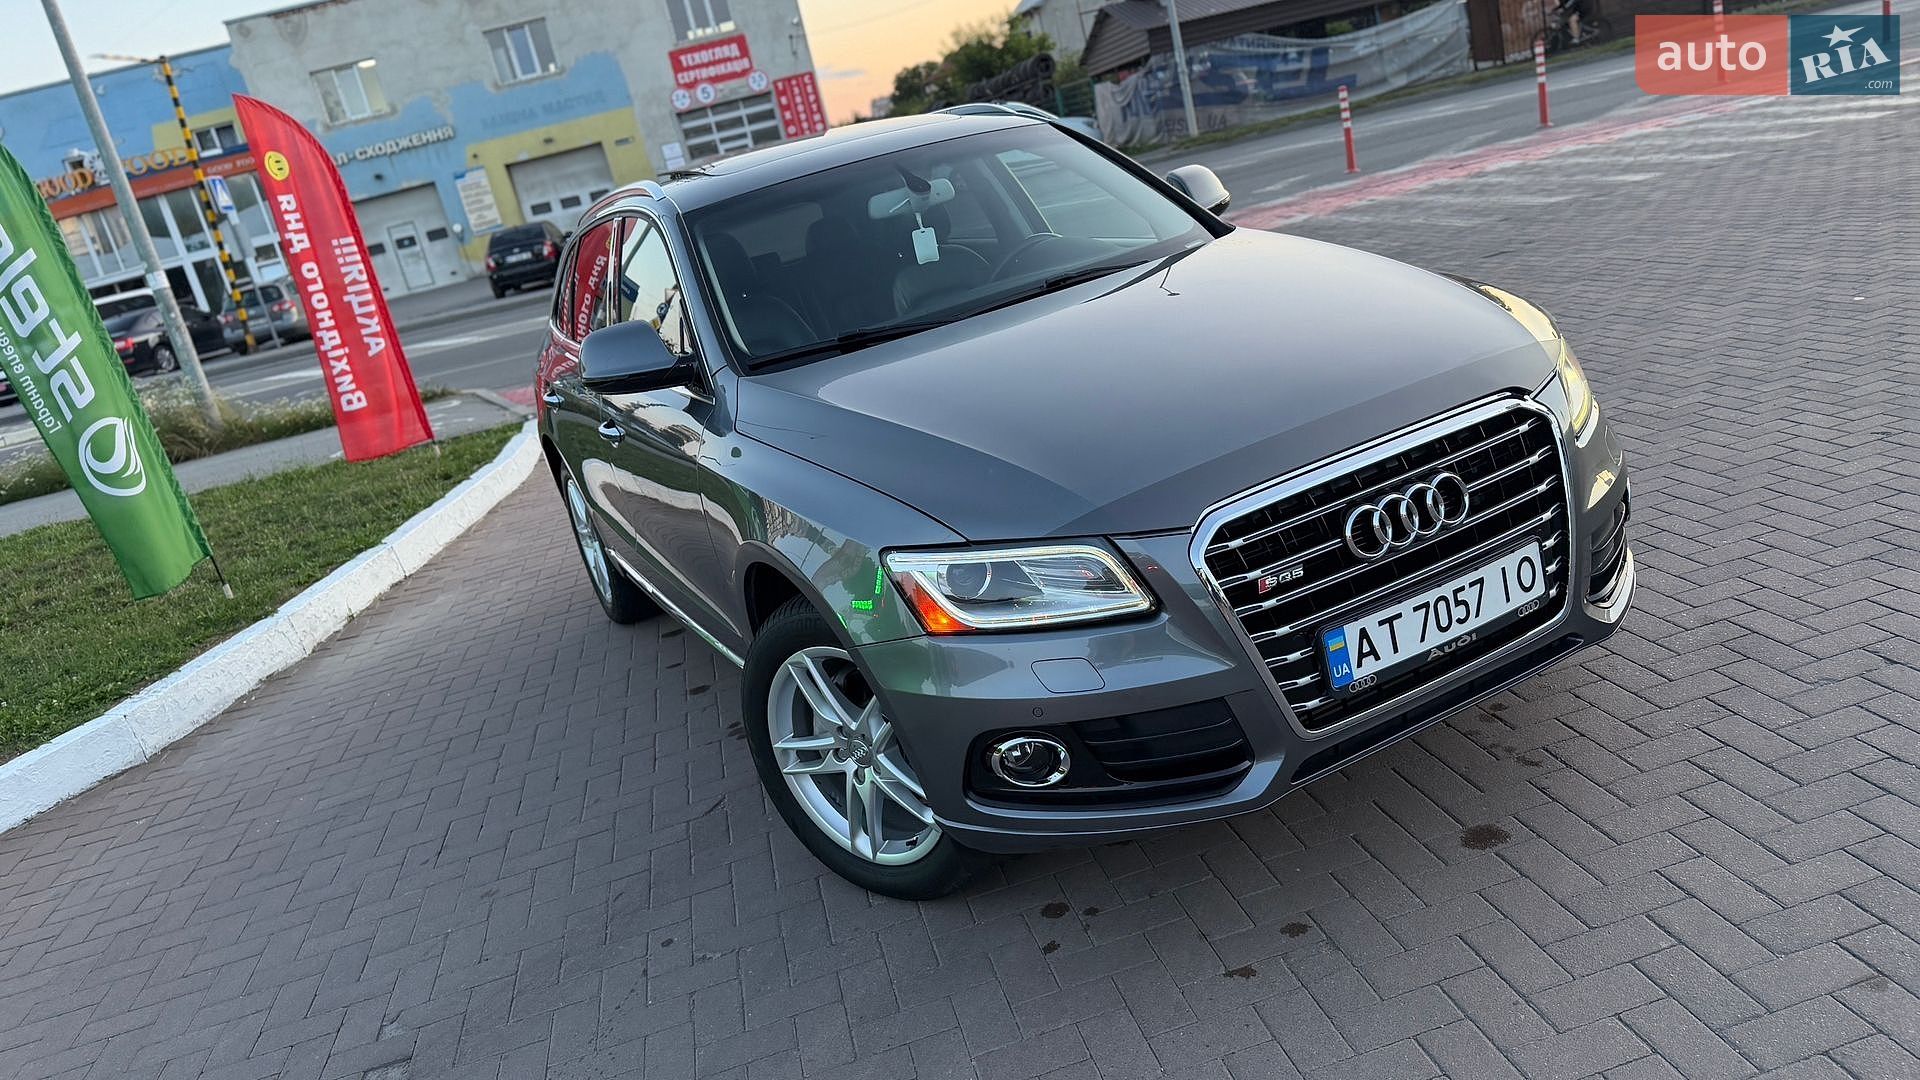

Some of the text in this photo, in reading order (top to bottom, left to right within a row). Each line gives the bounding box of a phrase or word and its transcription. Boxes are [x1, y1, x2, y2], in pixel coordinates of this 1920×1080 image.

[1333, 555, 1537, 679] UA AT 7057 IO
